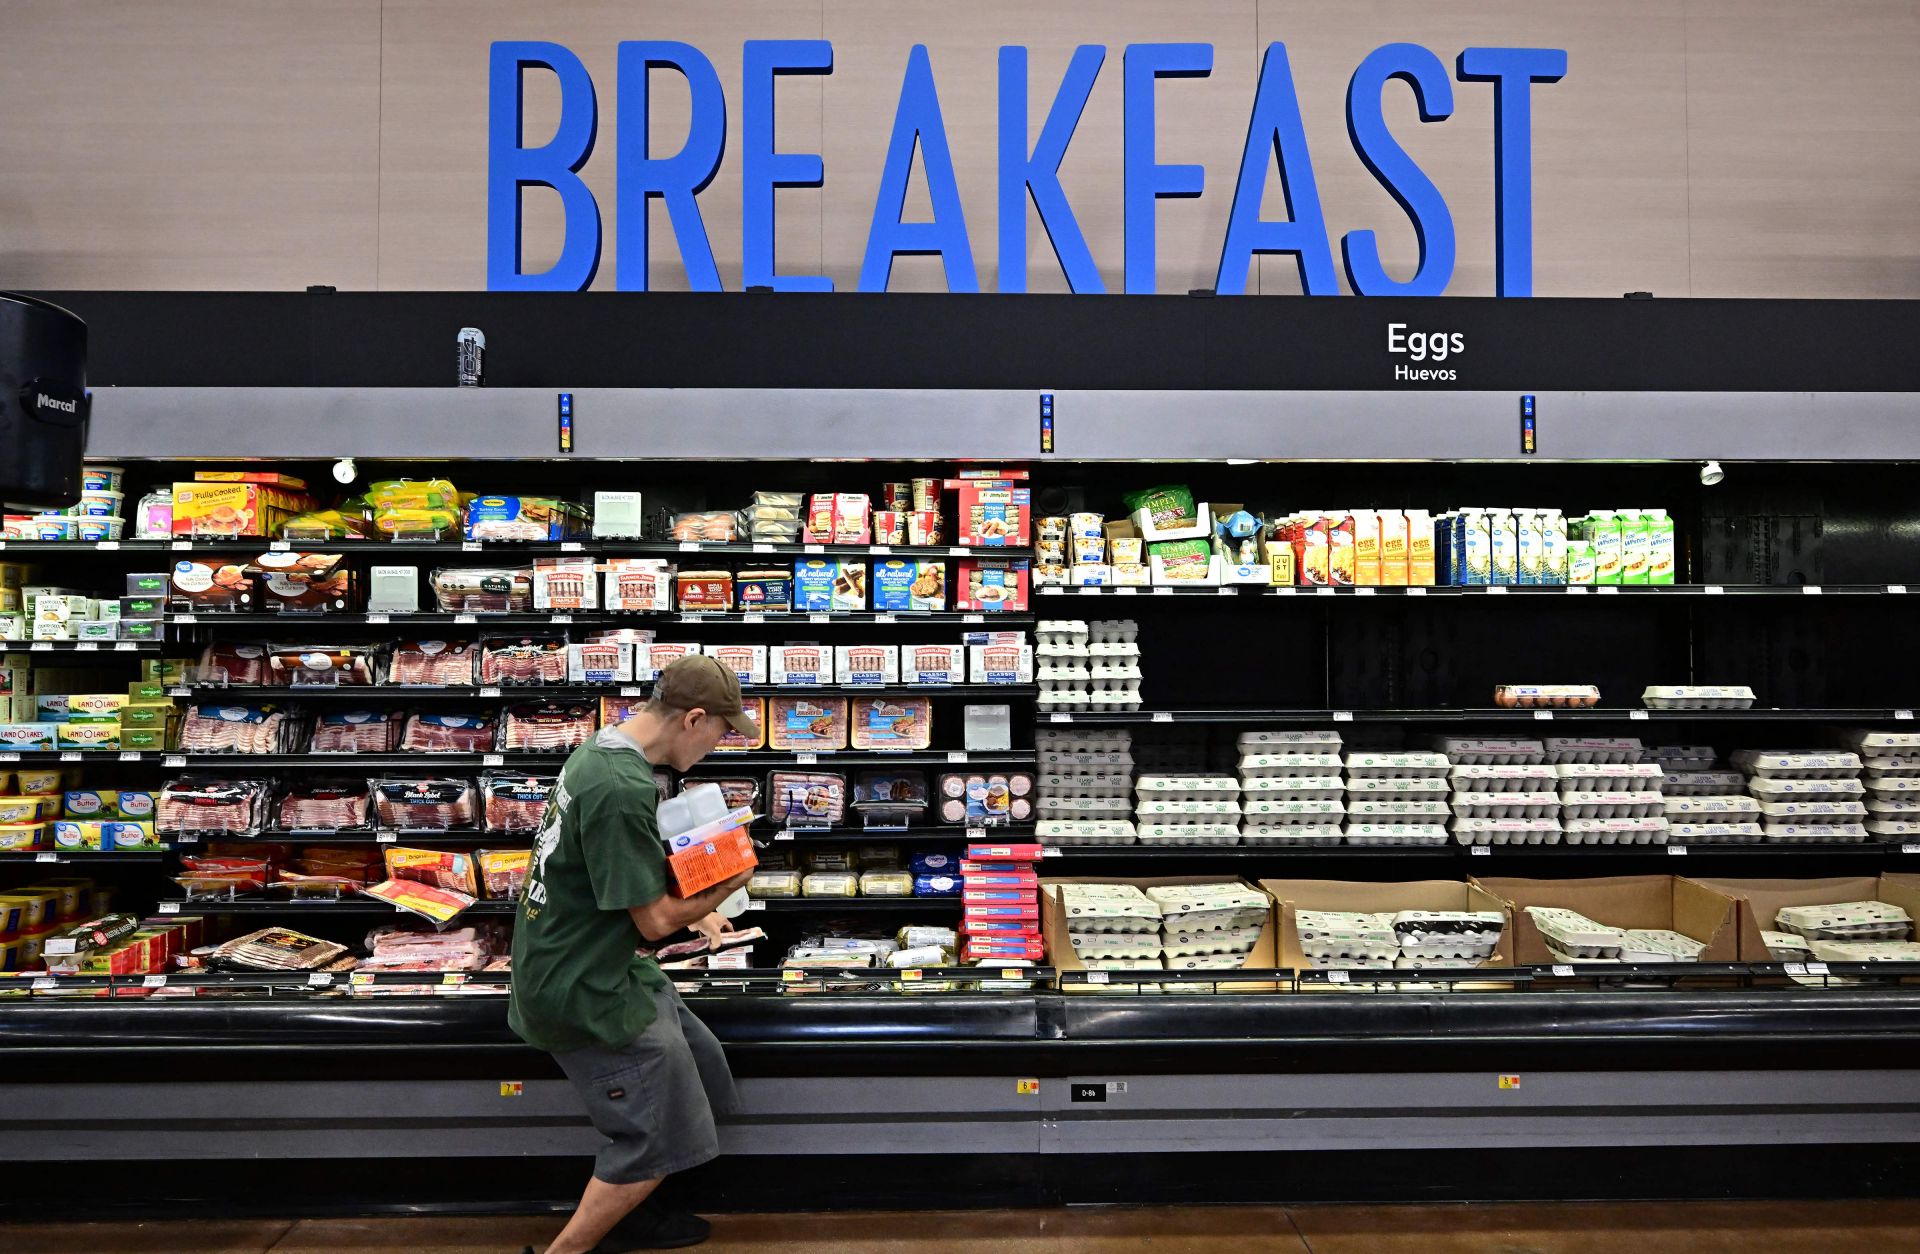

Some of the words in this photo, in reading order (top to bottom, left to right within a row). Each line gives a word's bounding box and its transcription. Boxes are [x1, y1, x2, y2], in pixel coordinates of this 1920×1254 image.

[488, 40, 1568, 299] BREAKFAST
[1388, 323, 1465, 361] Eggs
[1395, 364, 1457, 380] Huevos
[37, 393, 76, 414] Marcal
[195, 491, 213, 500] Fully
[214, 486, 242, 496] Cooked
[1160, 543, 1196, 554] SIMPLY
[1357, 539, 1375, 549] egg
[1385, 539, 1402, 549] egg
[1412, 539, 1430, 549] egg
